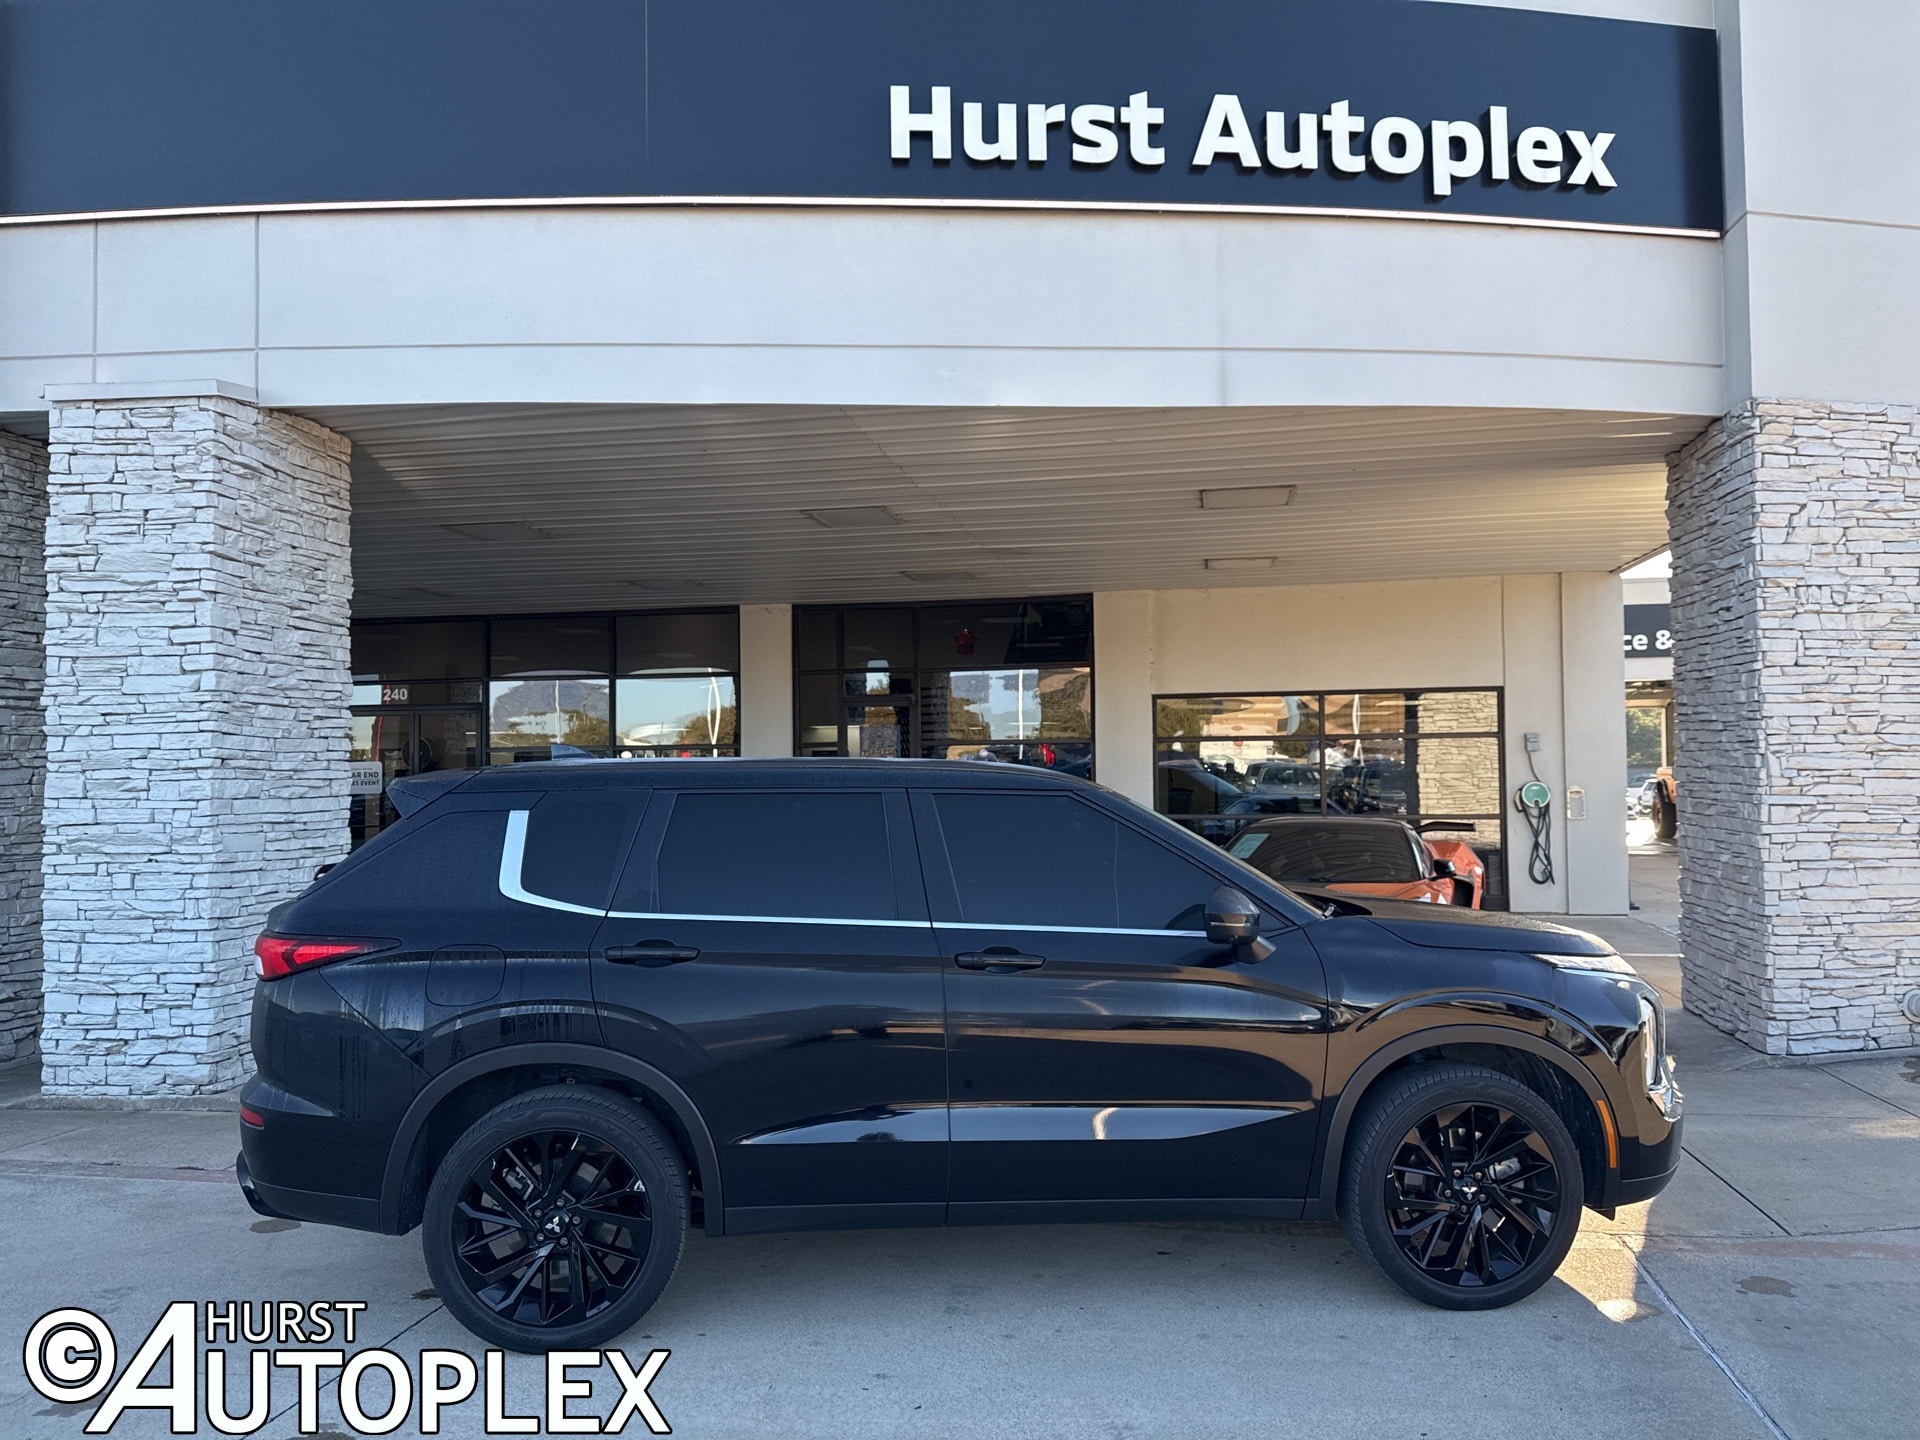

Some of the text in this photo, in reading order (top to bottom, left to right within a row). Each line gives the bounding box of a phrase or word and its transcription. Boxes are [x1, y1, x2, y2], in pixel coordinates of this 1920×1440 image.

[890, 85, 1620, 196] Hurst Autoplex
[383, 688, 408, 701] 240
[364, 771, 379, 779] END
